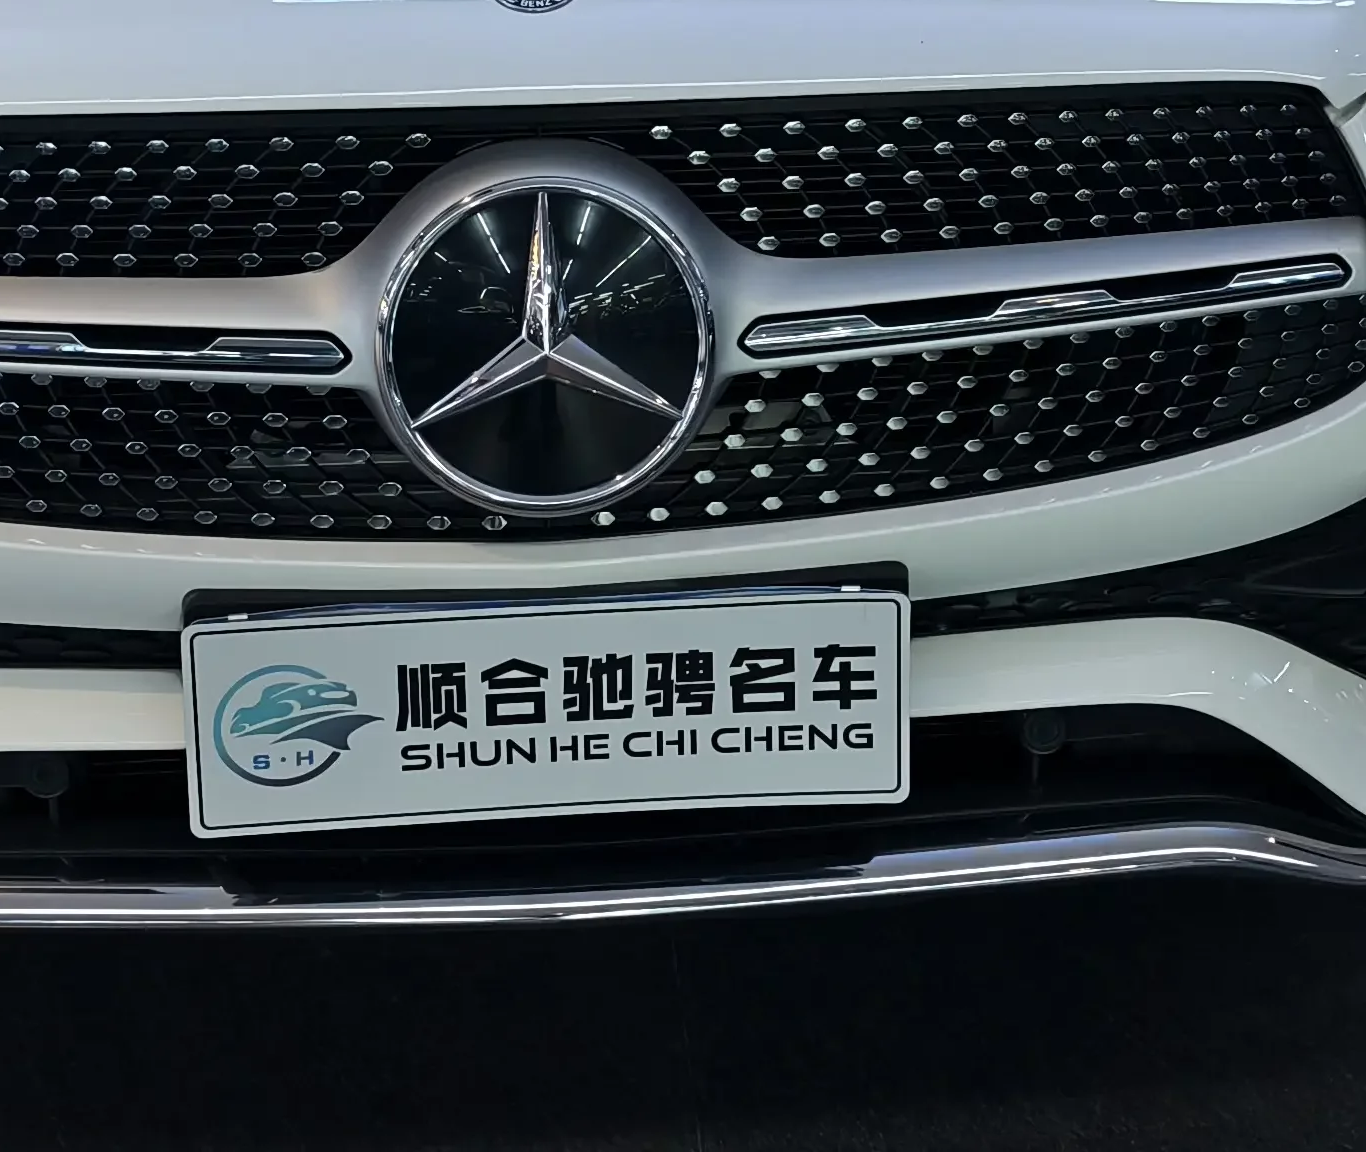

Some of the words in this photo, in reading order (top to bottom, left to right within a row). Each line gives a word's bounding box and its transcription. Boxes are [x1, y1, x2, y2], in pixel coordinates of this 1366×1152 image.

[396, 644, 878, 732] 顺合驰骋名车
[401, 740, 537, 772] SHUN
[550, 733, 610, 763] HE
[623, 728, 698, 758] CHI
[711, 722, 874, 754] CHENG
